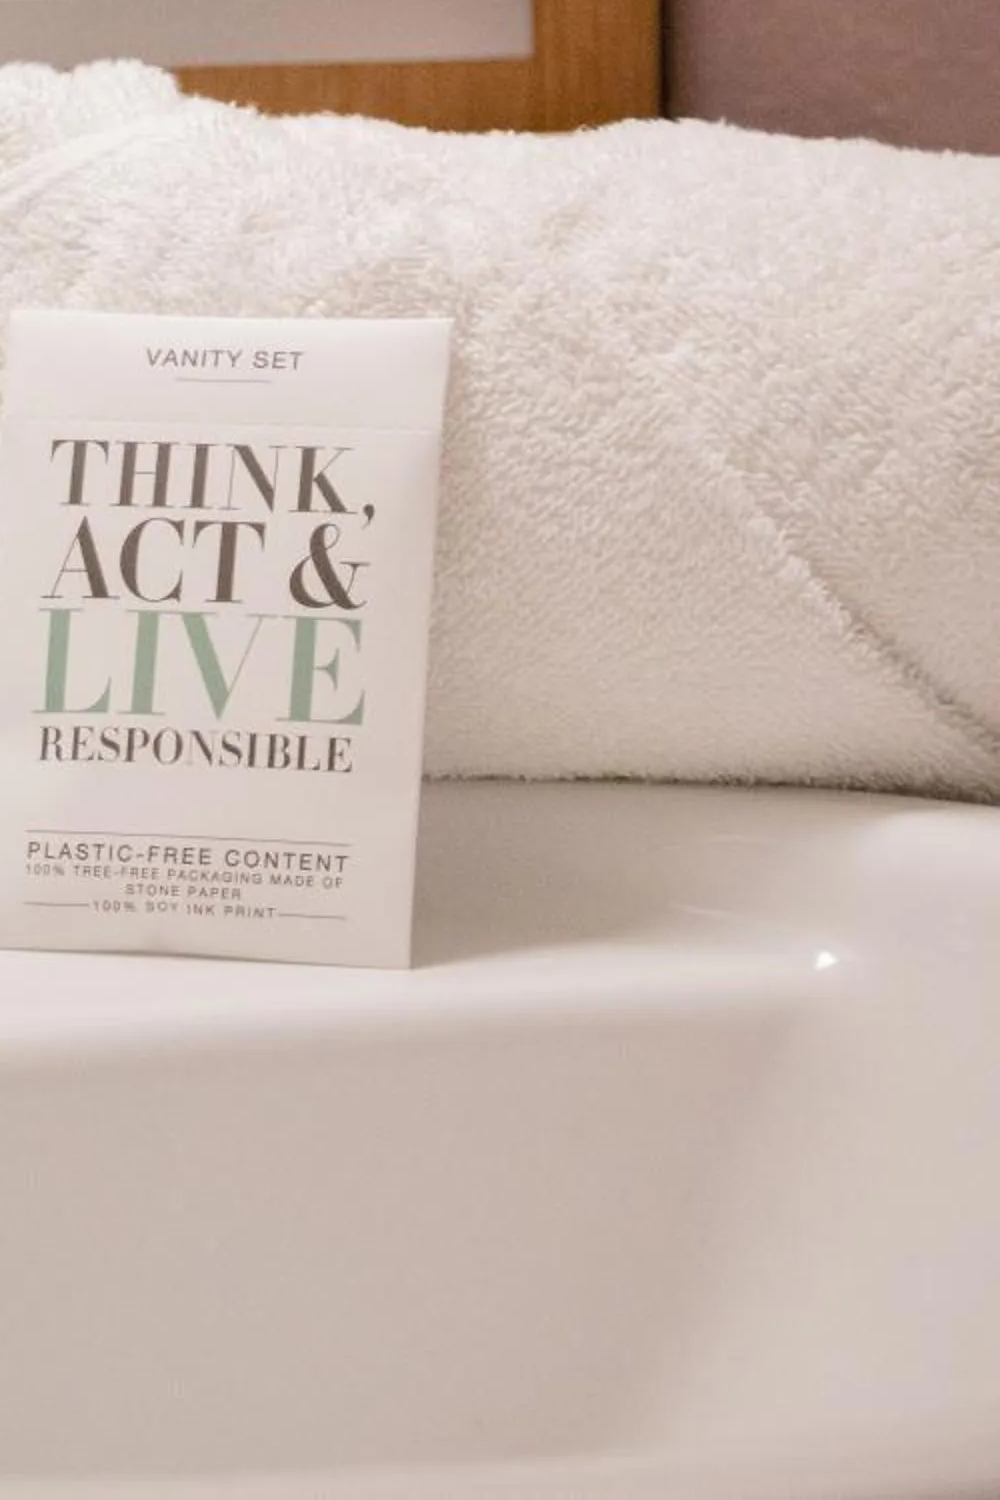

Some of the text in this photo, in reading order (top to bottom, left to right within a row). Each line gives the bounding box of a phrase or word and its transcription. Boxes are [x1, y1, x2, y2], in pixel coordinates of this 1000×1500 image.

[146, 348, 305, 371] VANITY SET
[50, 438, 375, 530] THINK,
[40, 515, 371, 611] ACT &
[31, 607, 366, 726] LIVE
[38, 725, 353, 774] RESPONSIBLE
[27, 841, 349, 872] PLASTIC-FREE CONTENT
[25, 863, 343, 889] 100% TREE-FREE PACKAGING MADE OF
[124, 883, 241, 900] STONE PAPER
[93, 900, 277, 918] 100% SOY INK PRINT
